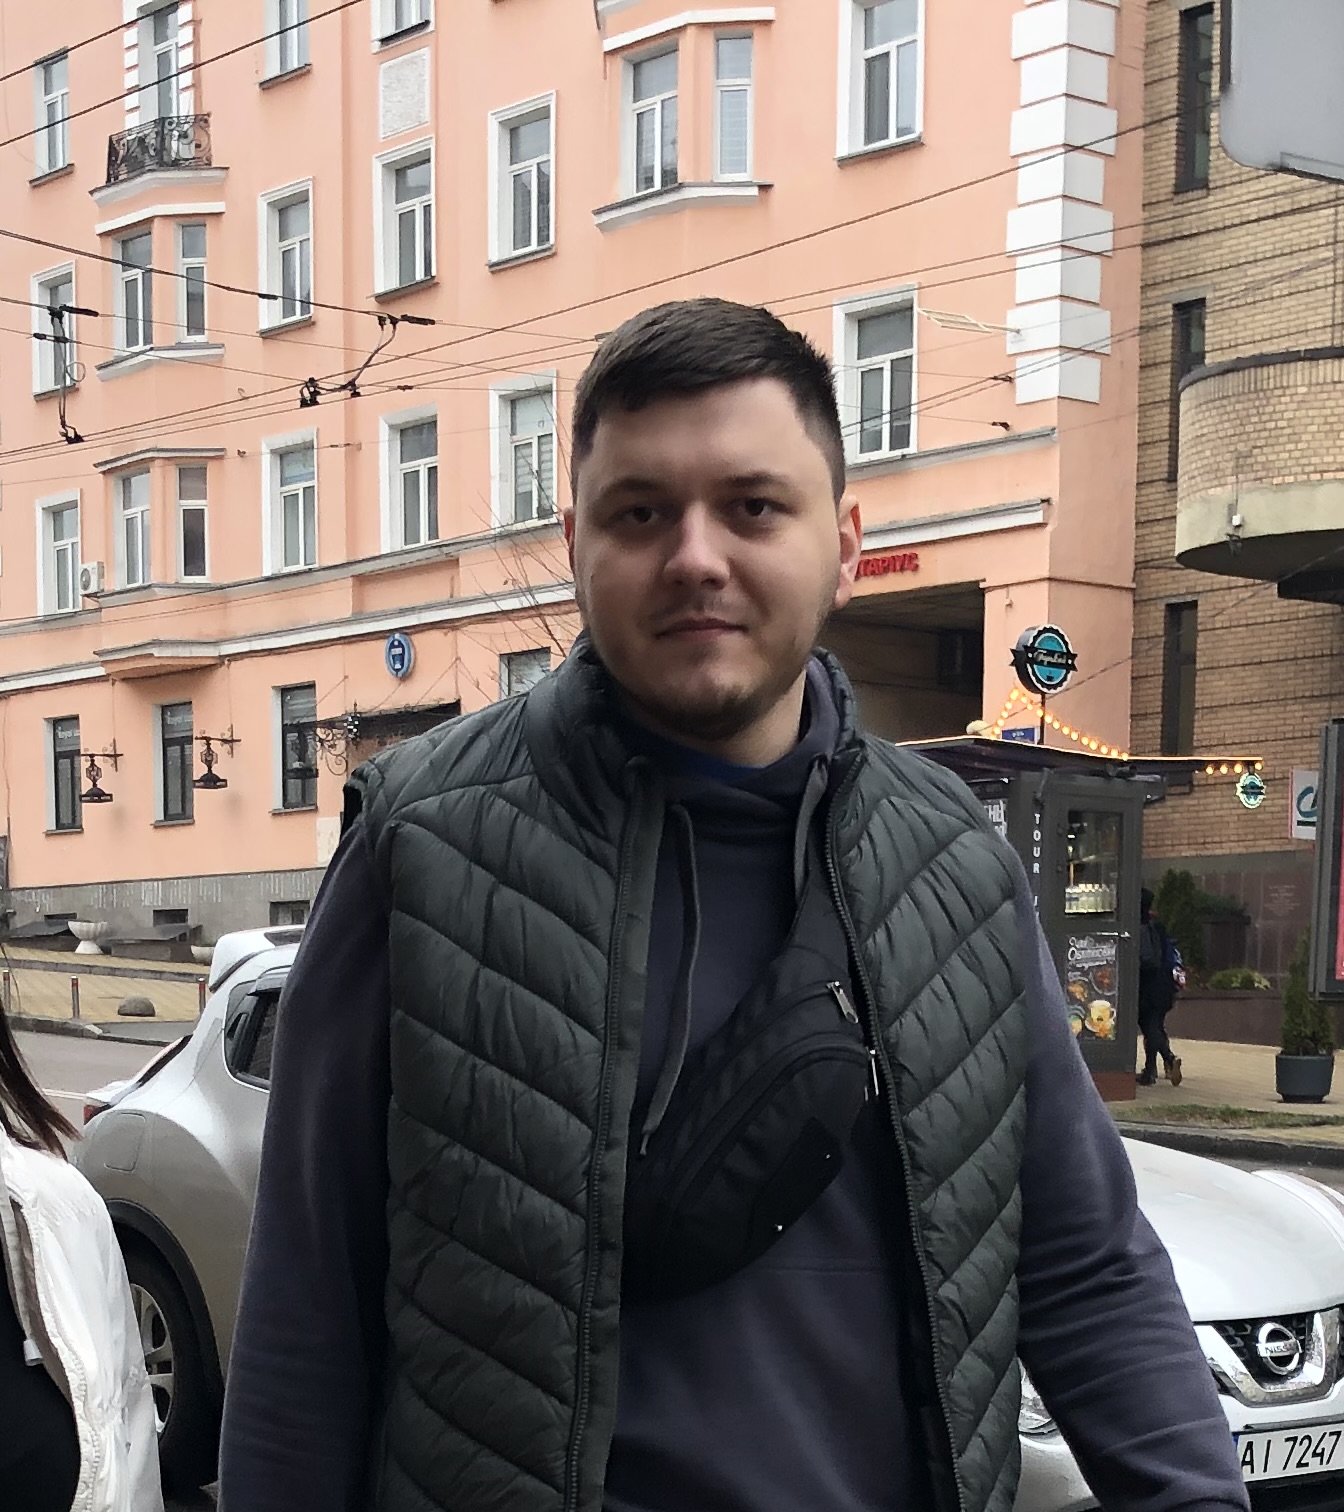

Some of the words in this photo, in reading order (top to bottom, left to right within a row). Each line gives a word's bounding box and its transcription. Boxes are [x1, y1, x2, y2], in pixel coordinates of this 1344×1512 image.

[1032, 813, 1042, 874] TOUR
[1241, 1439, 1272, 1474] AI
[1282, 1430, 1343, 1471] 7247
